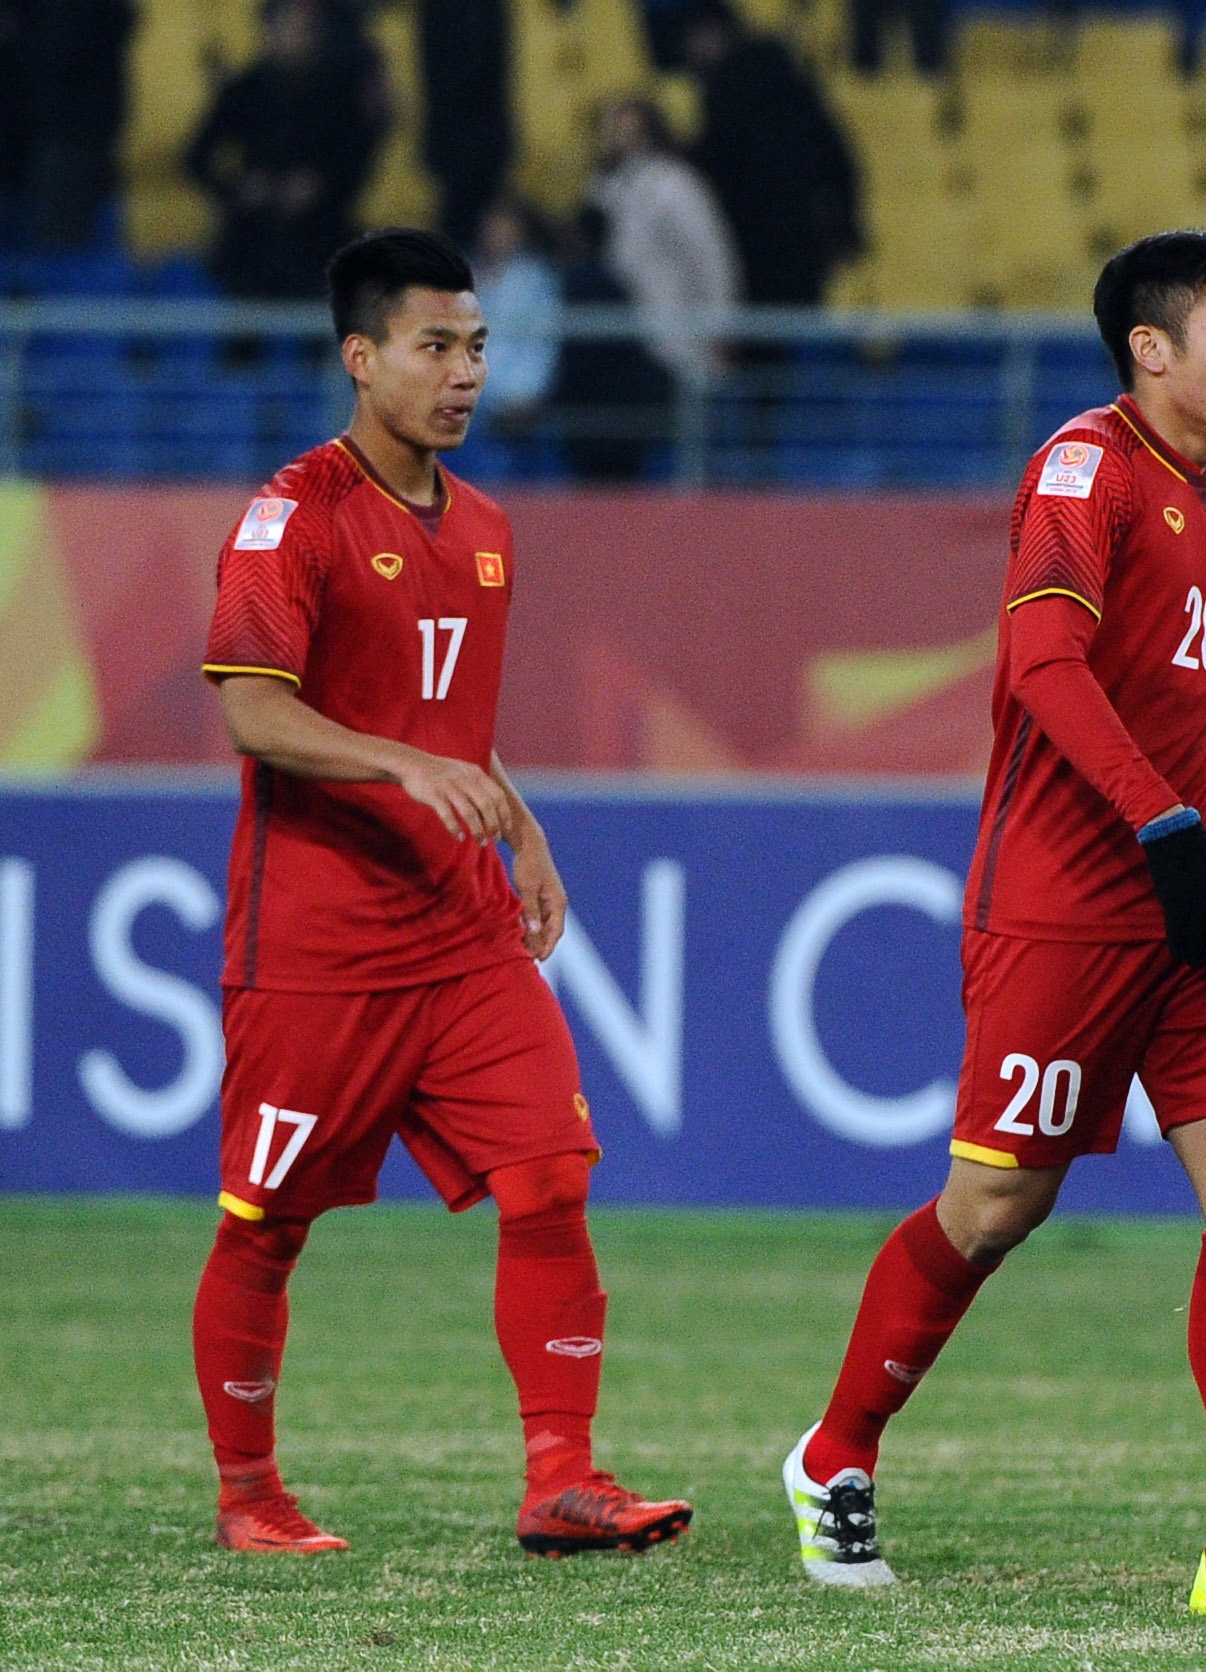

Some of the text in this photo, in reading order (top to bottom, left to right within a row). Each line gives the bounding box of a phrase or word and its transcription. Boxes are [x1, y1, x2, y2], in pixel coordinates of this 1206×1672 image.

[417, 617, 468, 700] 17
[993, 1052, 1082, 1136] 20
[248, 1102, 318, 1190] 17
